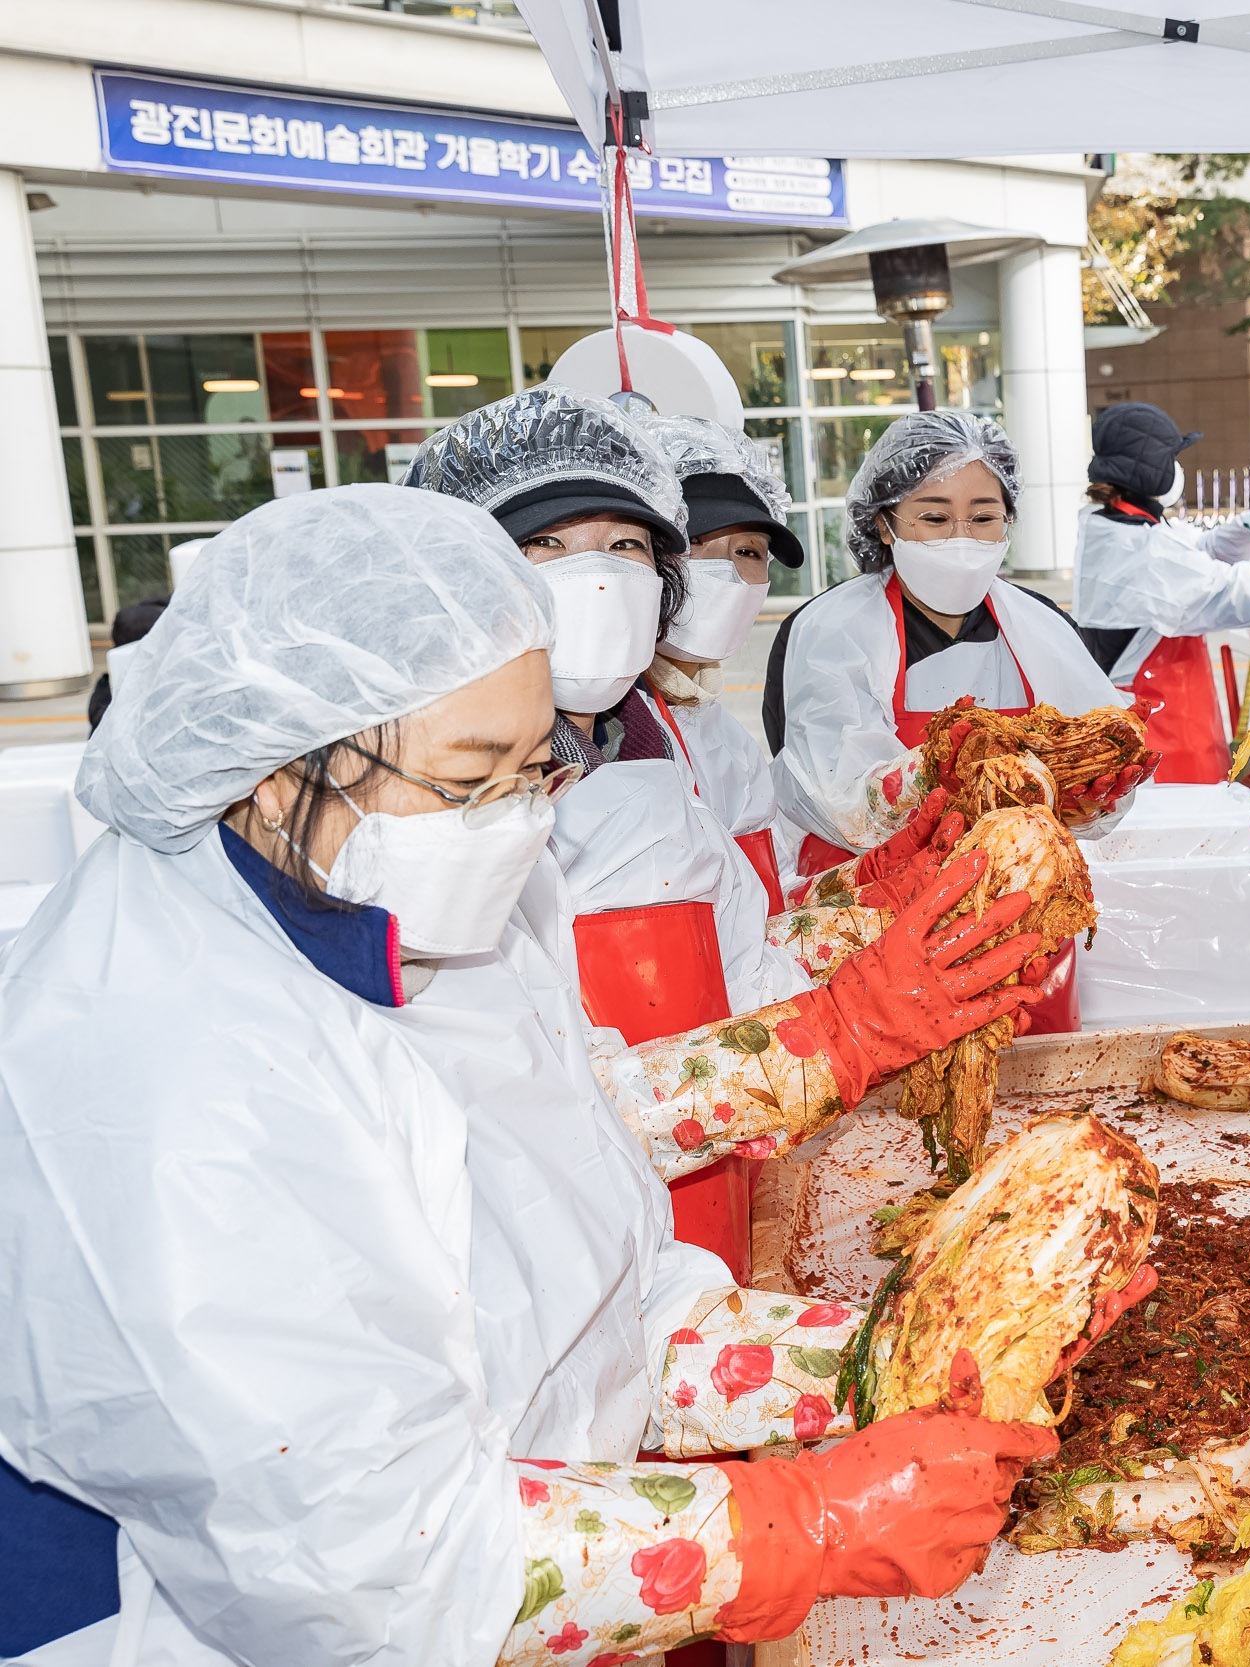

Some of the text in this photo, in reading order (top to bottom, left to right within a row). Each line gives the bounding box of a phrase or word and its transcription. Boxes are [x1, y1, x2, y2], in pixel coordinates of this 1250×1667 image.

[129, 99, 714, 196] 광진문화예술회관 겨울학기 수생 모집
